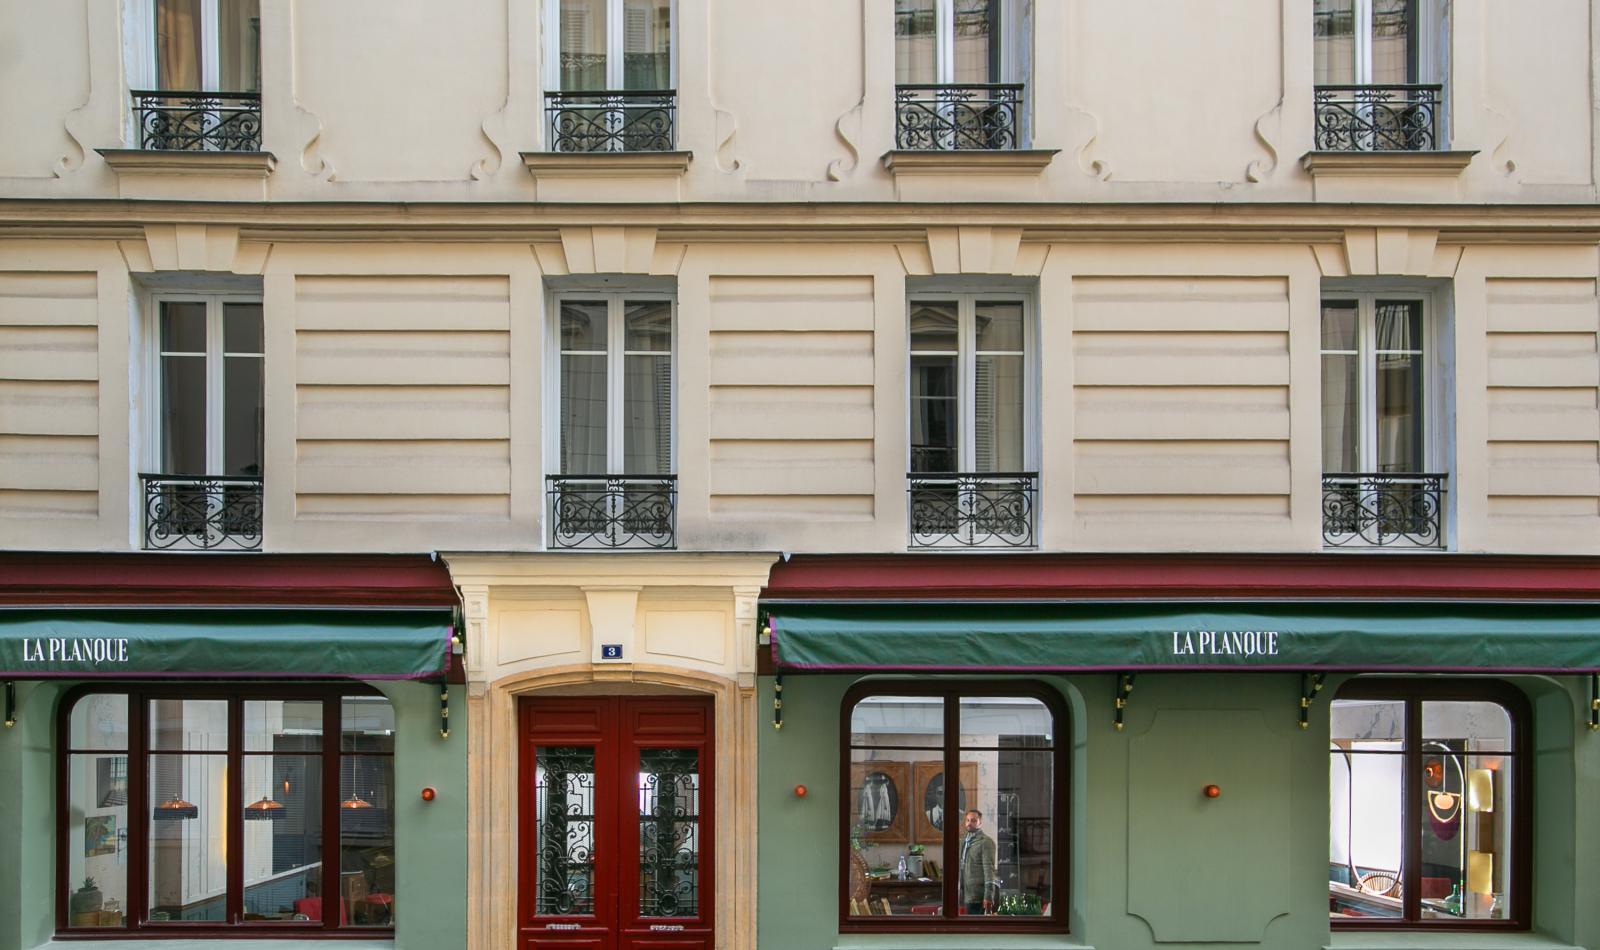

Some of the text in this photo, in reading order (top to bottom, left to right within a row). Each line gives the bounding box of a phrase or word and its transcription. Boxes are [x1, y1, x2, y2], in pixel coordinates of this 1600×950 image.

[23, 638, 129, 666] LA PLANQUE
[608, 647, 616, 656] 3
[1173, 631, 1279, 659] LA PLANQUE
